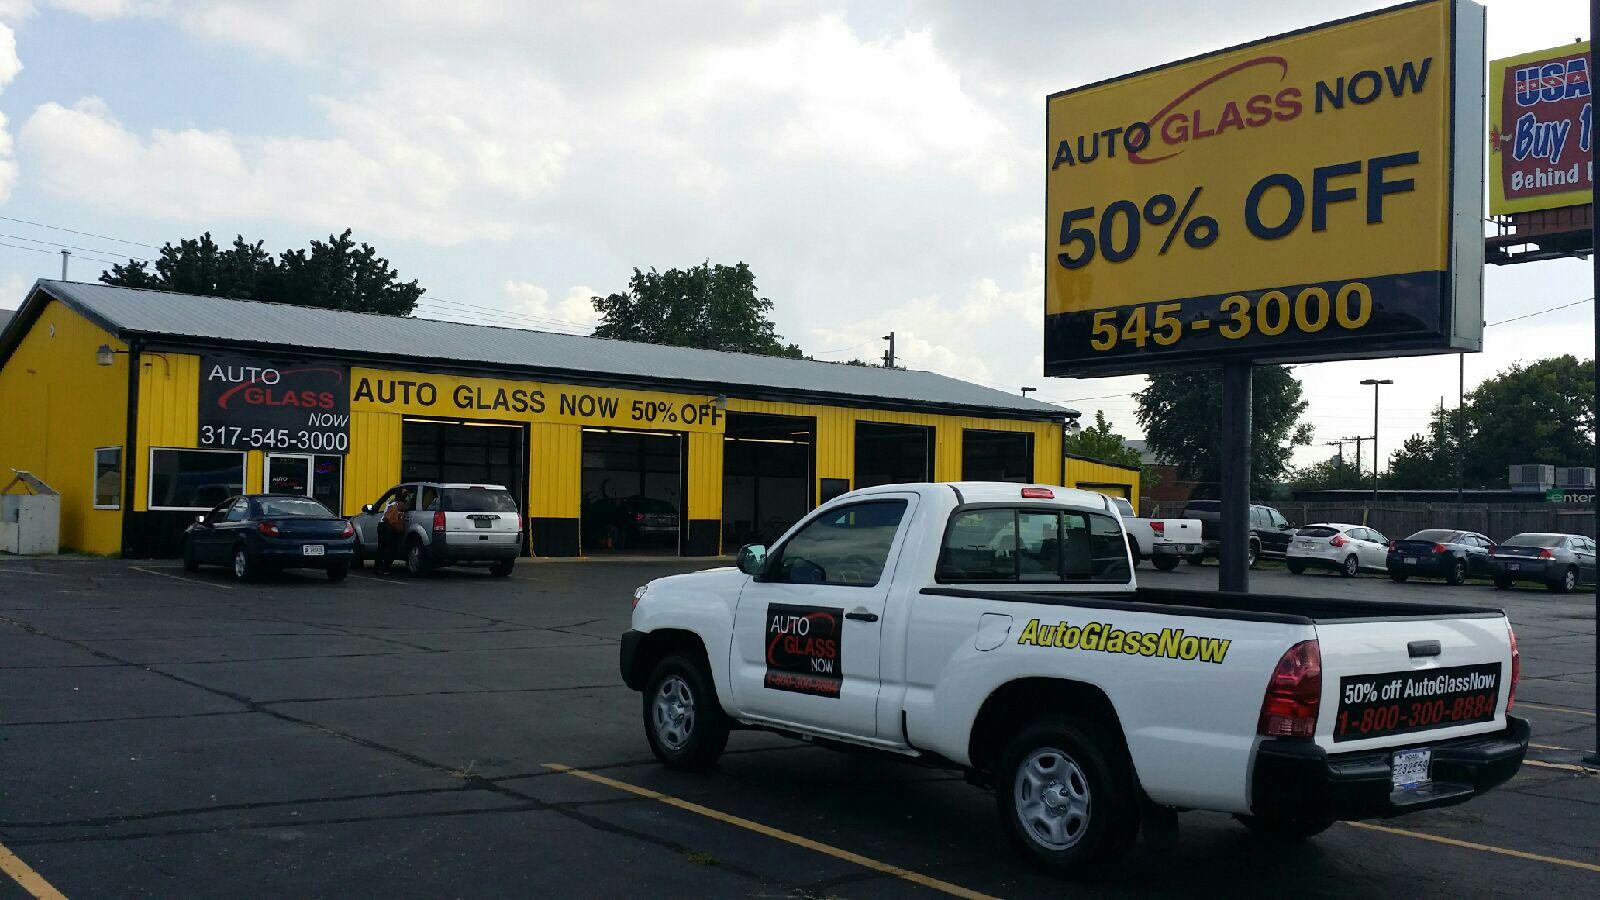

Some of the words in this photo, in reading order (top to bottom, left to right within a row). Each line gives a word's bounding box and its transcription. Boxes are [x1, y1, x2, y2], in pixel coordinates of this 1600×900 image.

[1515, 57, 1592, 107] USA
[1052, 121, 1151, 170] AUTO
[1161, 87, 1303, 145] GLASS
[1314, 57, 1433, 113] NOW
[1512, 112, 1571, 165] Buy
[1511, 163, 1579, 191] Behind
[1057, 186, 1219, 269] 50%
[1244, 151, 1420, 240] OFF
[1090, 282, 1373, 352] 545-3000
[208, 364, 280, 385] AUTO
[244, 387, 335, 410] GLASS
[353, 378, 437, 406] AUTO
[453, 384, 546, 414] GLASS
[559, 393, 619, 419] NOW
[631, 400, 678, 423] 50%
[308, 412, 349, 427] NOW
[201, 425, 348, 450] 317-545-3000
[770, 615, 810, 636] AUTO
[1018, 618, 1232, 664] AutoGlassNow
[784, 635, 836, 658] GLASS
[811, 657, 834, 674] NOW
[1345, 681, 1377, 705] 50%
[1381, 680, 1402, 700] off
[1404, 672, 1496, 699] AutoGlassNow
[1338, 693, 1495, 737] 1-800-300-8884
